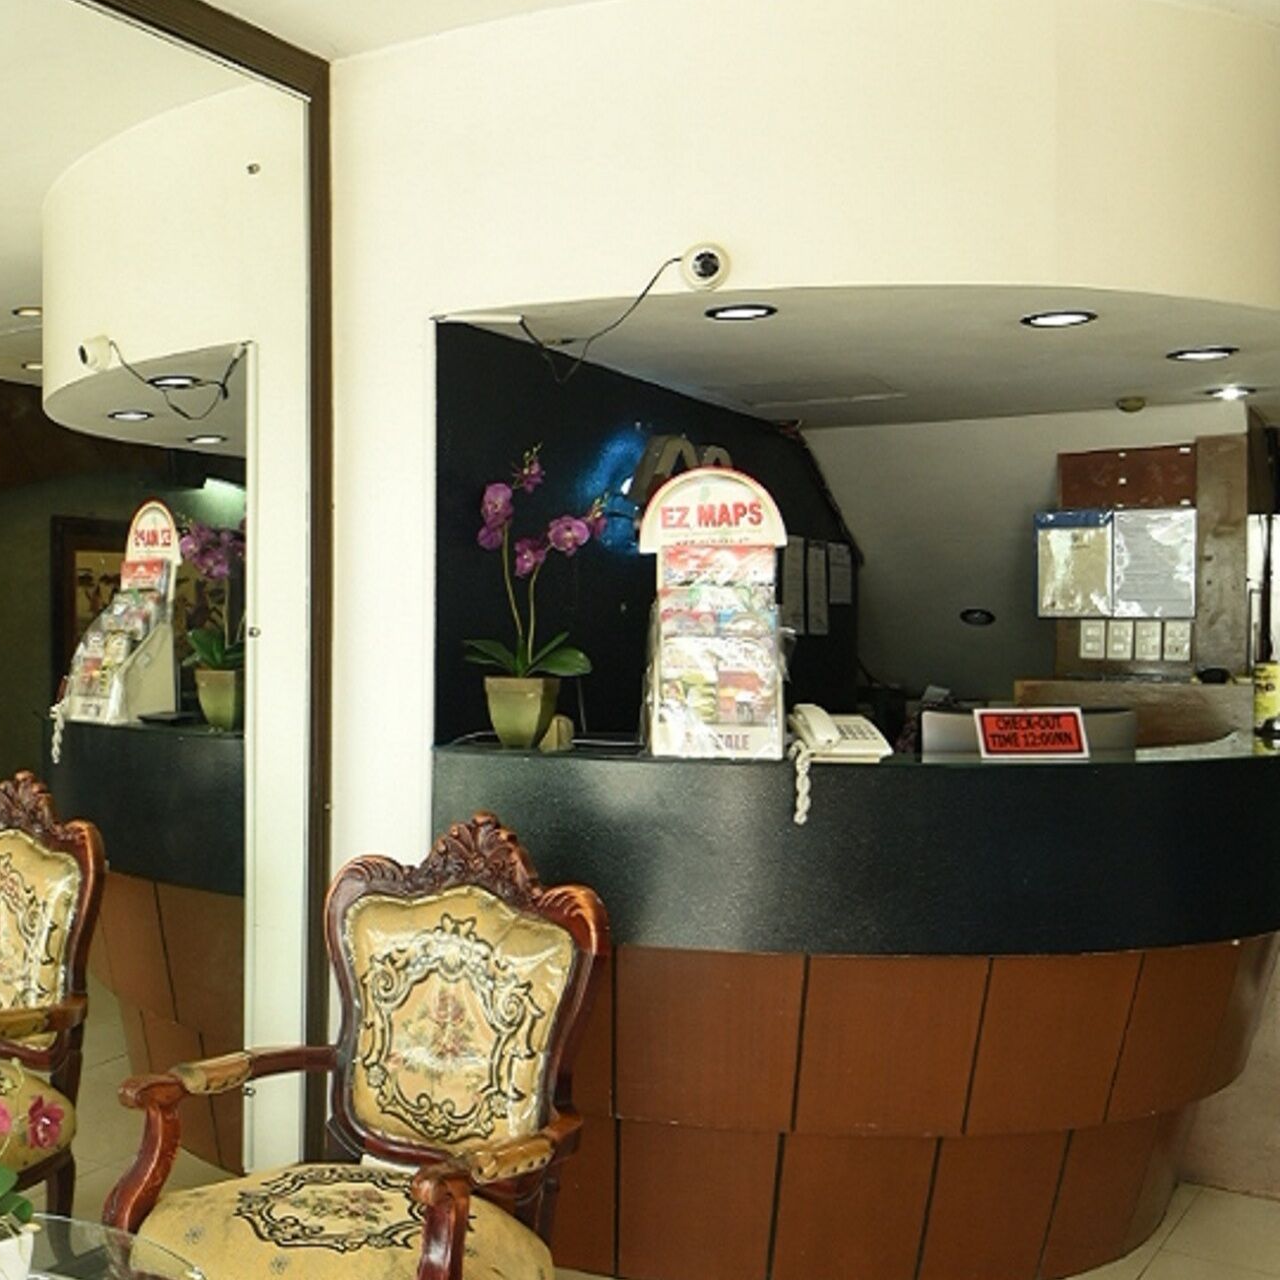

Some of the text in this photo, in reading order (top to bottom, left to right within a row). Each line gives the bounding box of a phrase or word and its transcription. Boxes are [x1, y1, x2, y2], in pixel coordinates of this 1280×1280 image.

[660, 499, 764, 529] EZ MAPS
[996, 715, 1063, 730] CHECK-OUT
[989, 732, 1020, 748] TIME
